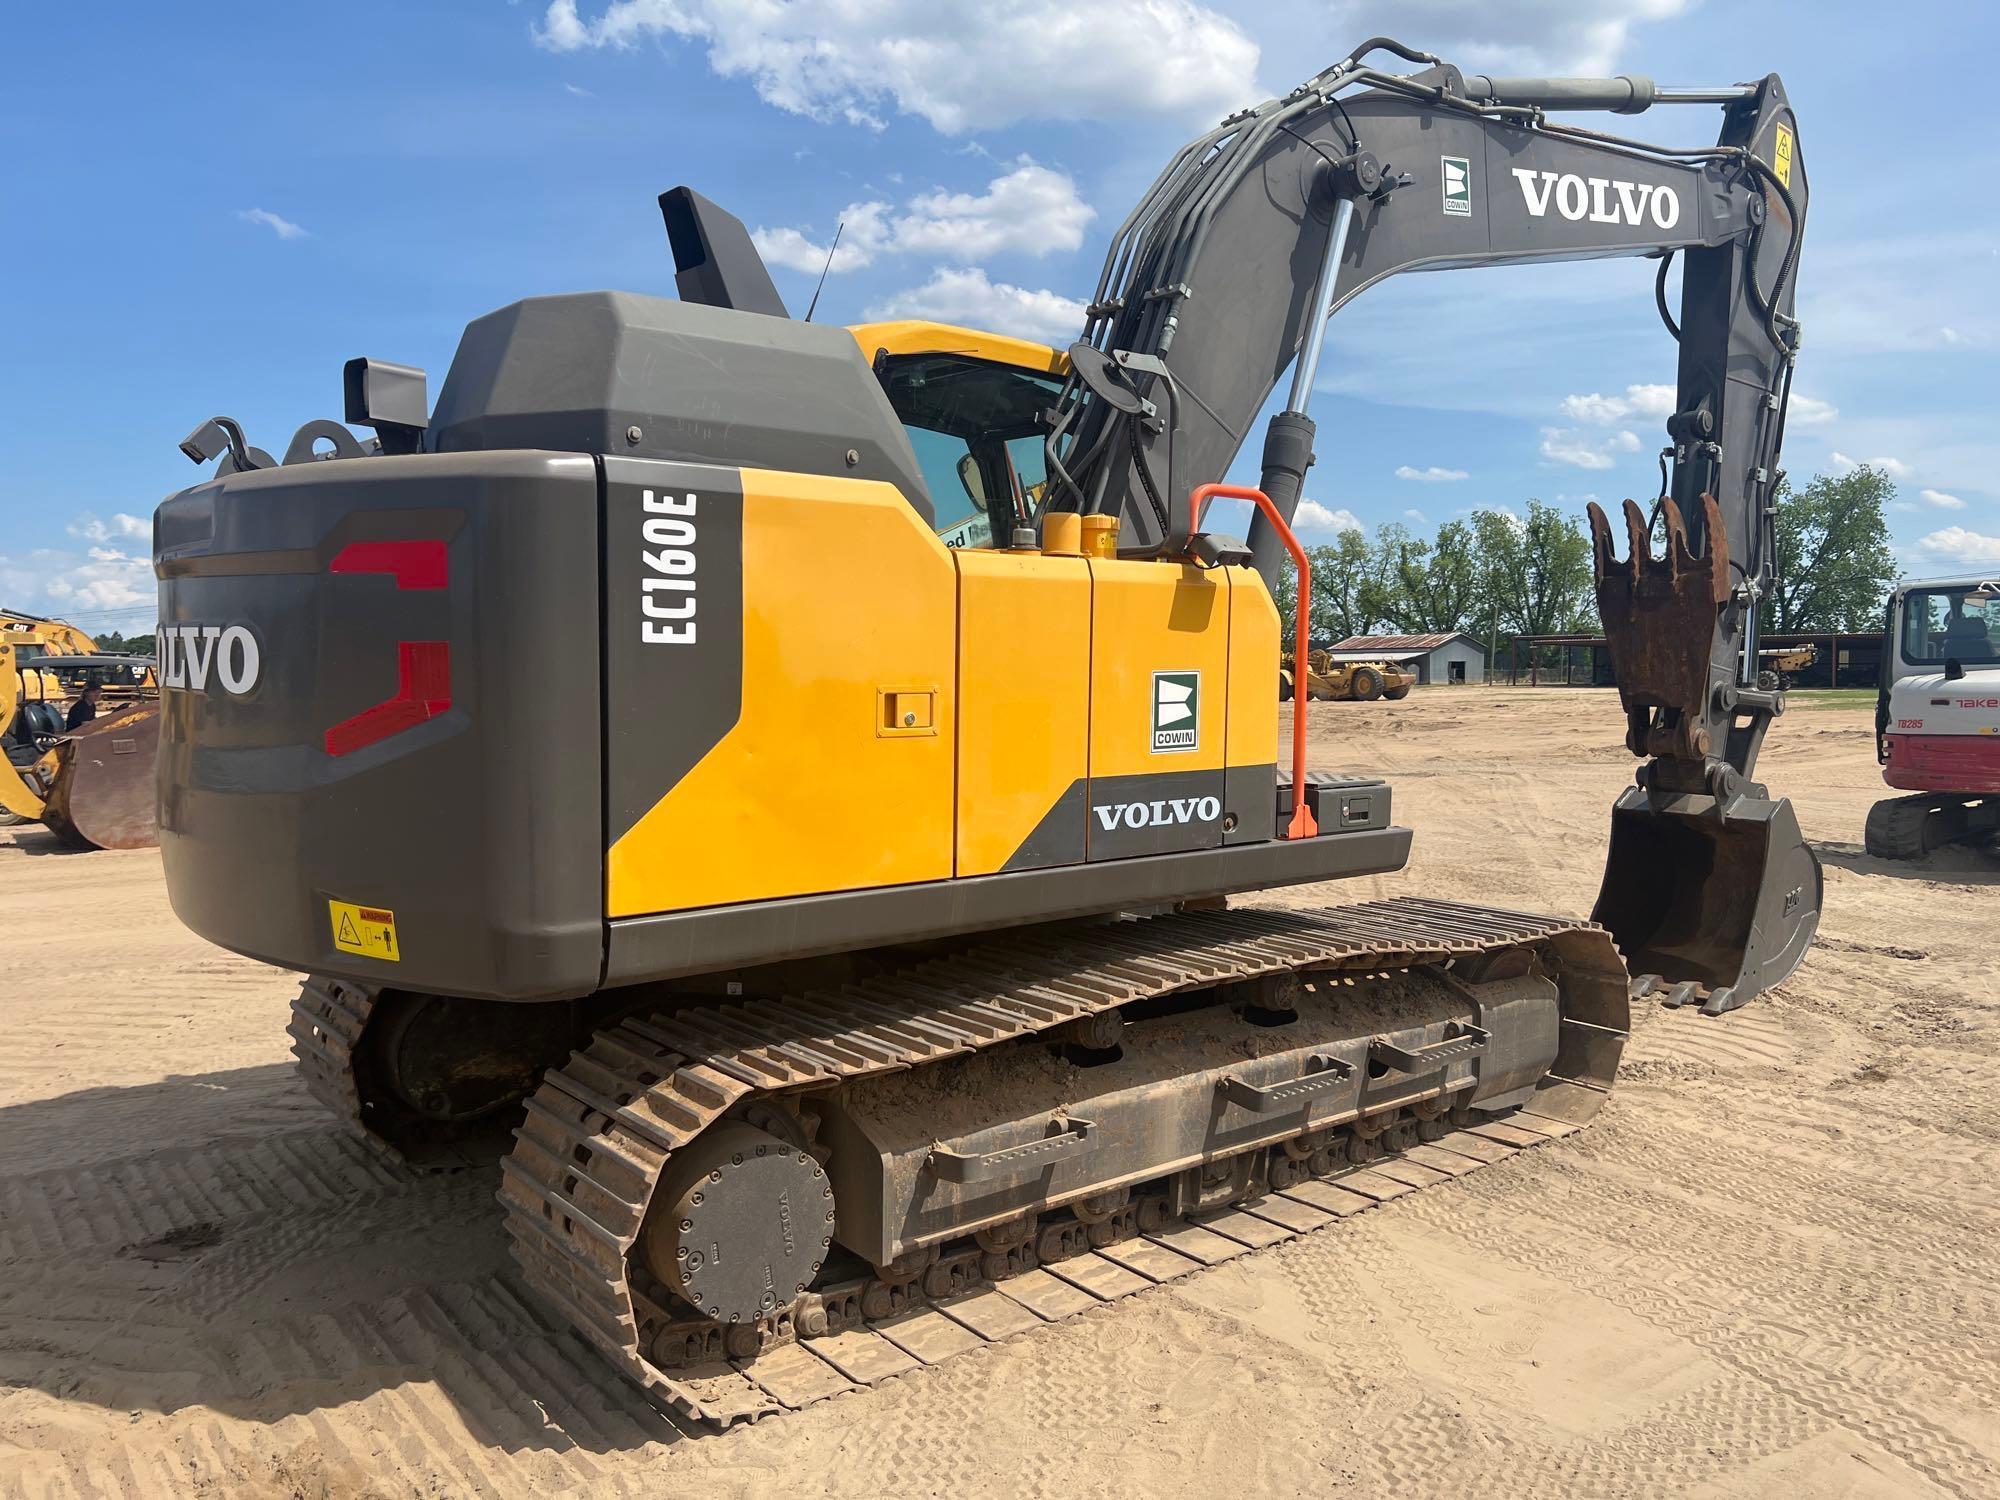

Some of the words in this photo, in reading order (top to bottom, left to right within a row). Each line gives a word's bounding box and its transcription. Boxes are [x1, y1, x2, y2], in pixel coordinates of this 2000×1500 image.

[1512, 168, 1680, 229] VOLVO
[1446, 200, 1468, 209] COWIN
[642, 489, 697, 644] EC160E
[13, 623, 28, 632] CAT
[132, 666, 147, 675] CAT
[1897, 719, 1924, 729] TB285
[1157, 731, 1193, 744] COWIN
[1093, 796, 1221, 831] VOLVO
